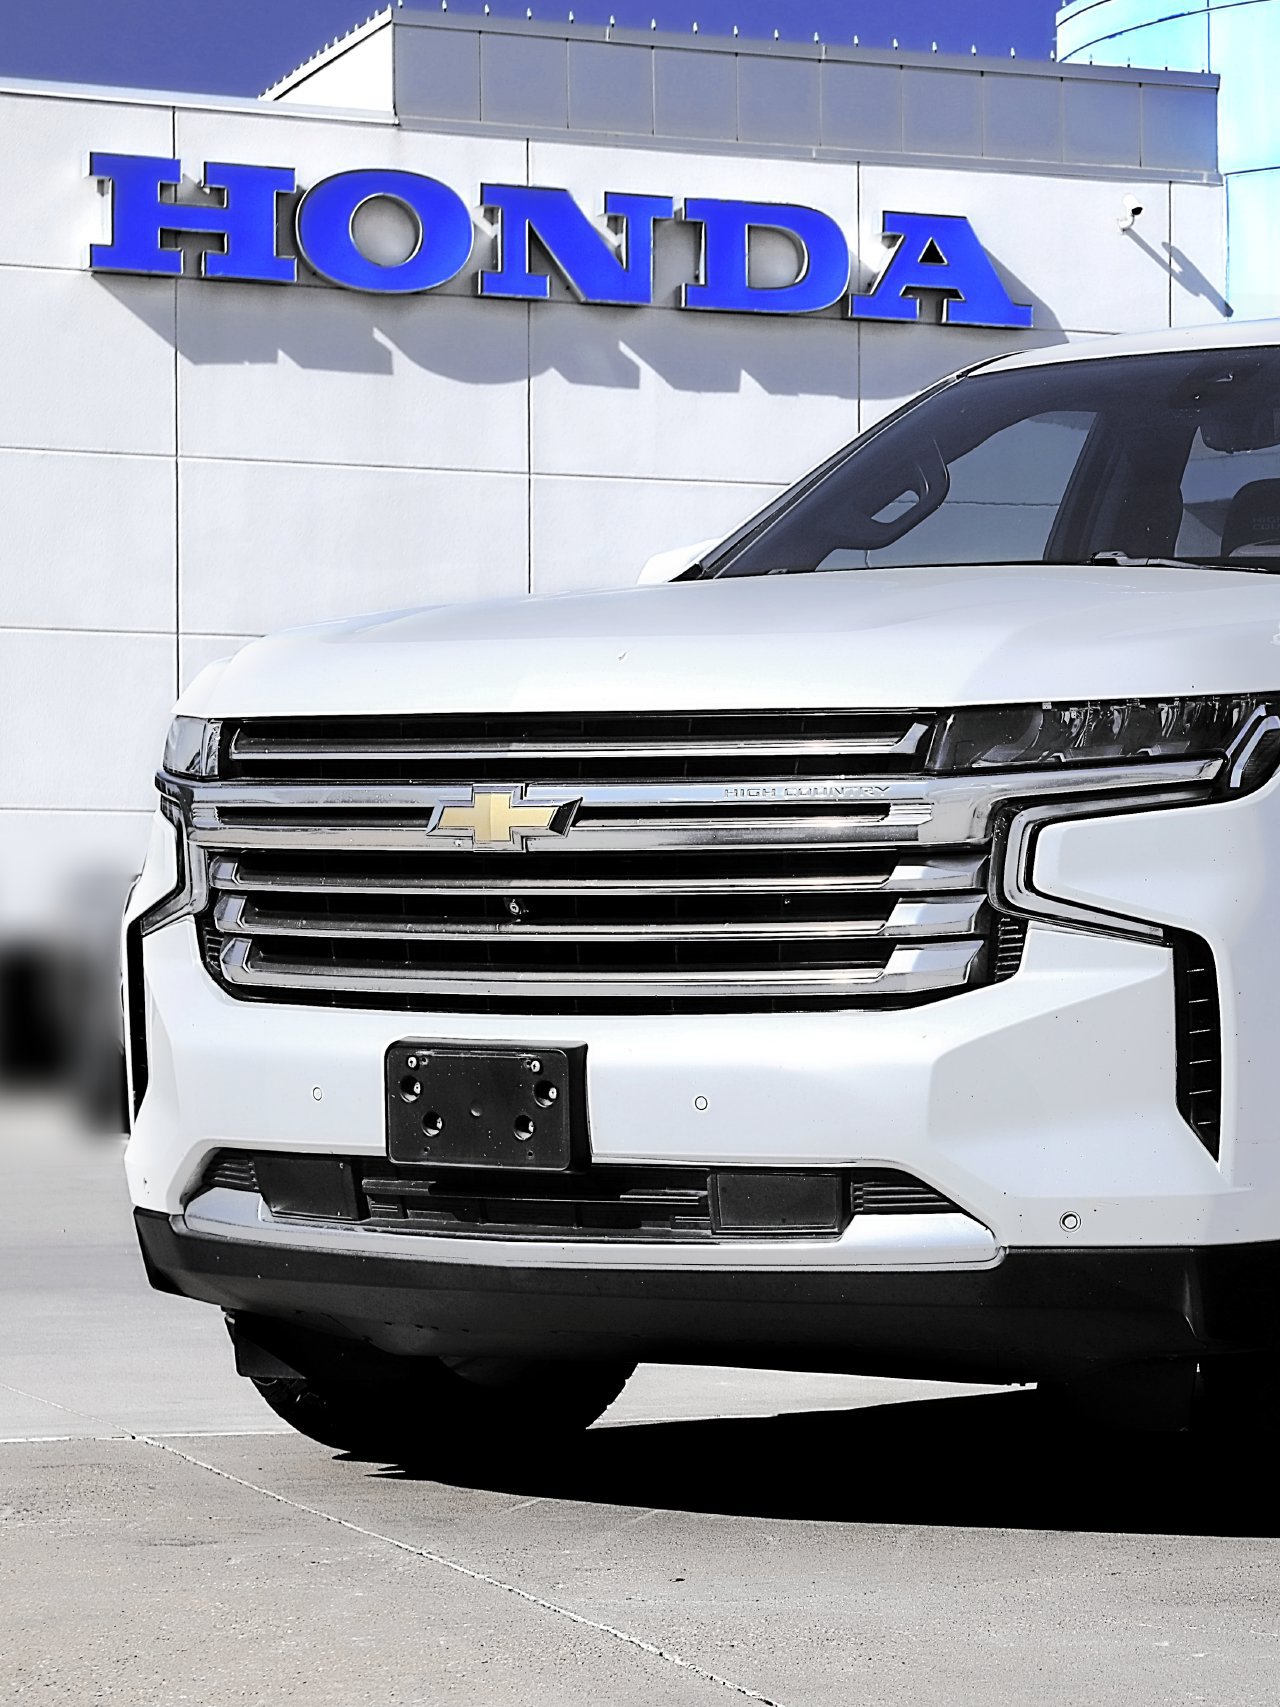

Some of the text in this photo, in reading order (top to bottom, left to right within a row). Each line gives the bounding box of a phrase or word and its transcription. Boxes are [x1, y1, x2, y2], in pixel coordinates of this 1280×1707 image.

[89, 151, 1034, 328] HONDA
[724, 786, 891, 798] HIGH COUNTRY
